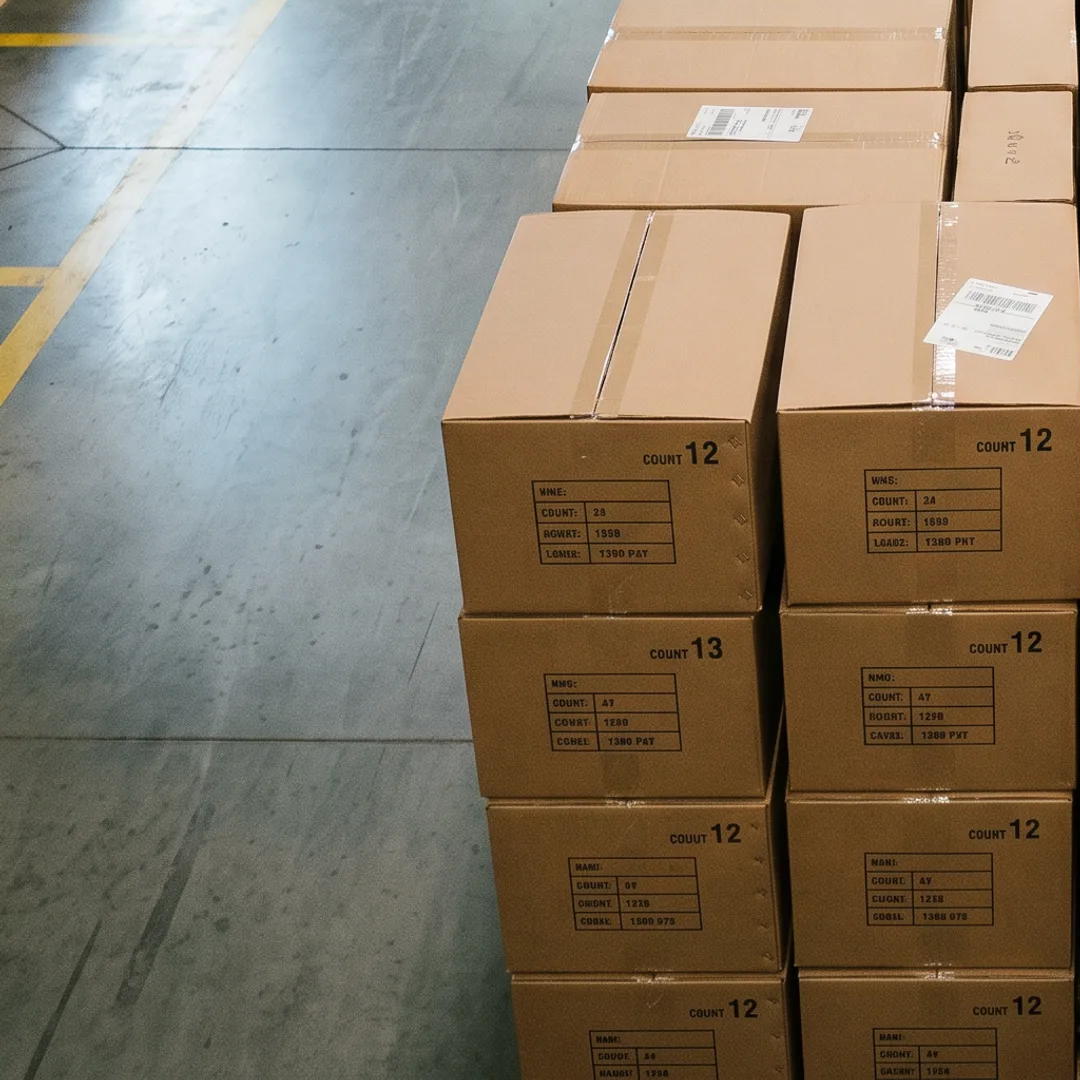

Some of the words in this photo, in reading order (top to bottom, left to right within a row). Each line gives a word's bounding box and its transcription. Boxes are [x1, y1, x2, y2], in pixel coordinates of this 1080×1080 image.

[976, 442, 1016, 452] COUNT
[1020, 428, 1052, 452] 12
[643, 454, 682, 465] COUNT
[685, 441, 719, 464] 12
[650, 649, 688, 659] COUNT
[691, 637, 723, 659] 13
[969, 644, 1008, 654] COUNT
[1011, 631, 1042, 653] 12
[710, 823, 741, 843] 12
[969, 830, 1006, 839] COUNT
[1009, 819, 1039, 839] 12
[689, 1009, 724, 1018] COUNT
[728, 999, 758, 1018] 12
[973, 1006, 1009, 1016] COUNT
[1012, 996, 1042, 1015] 12
